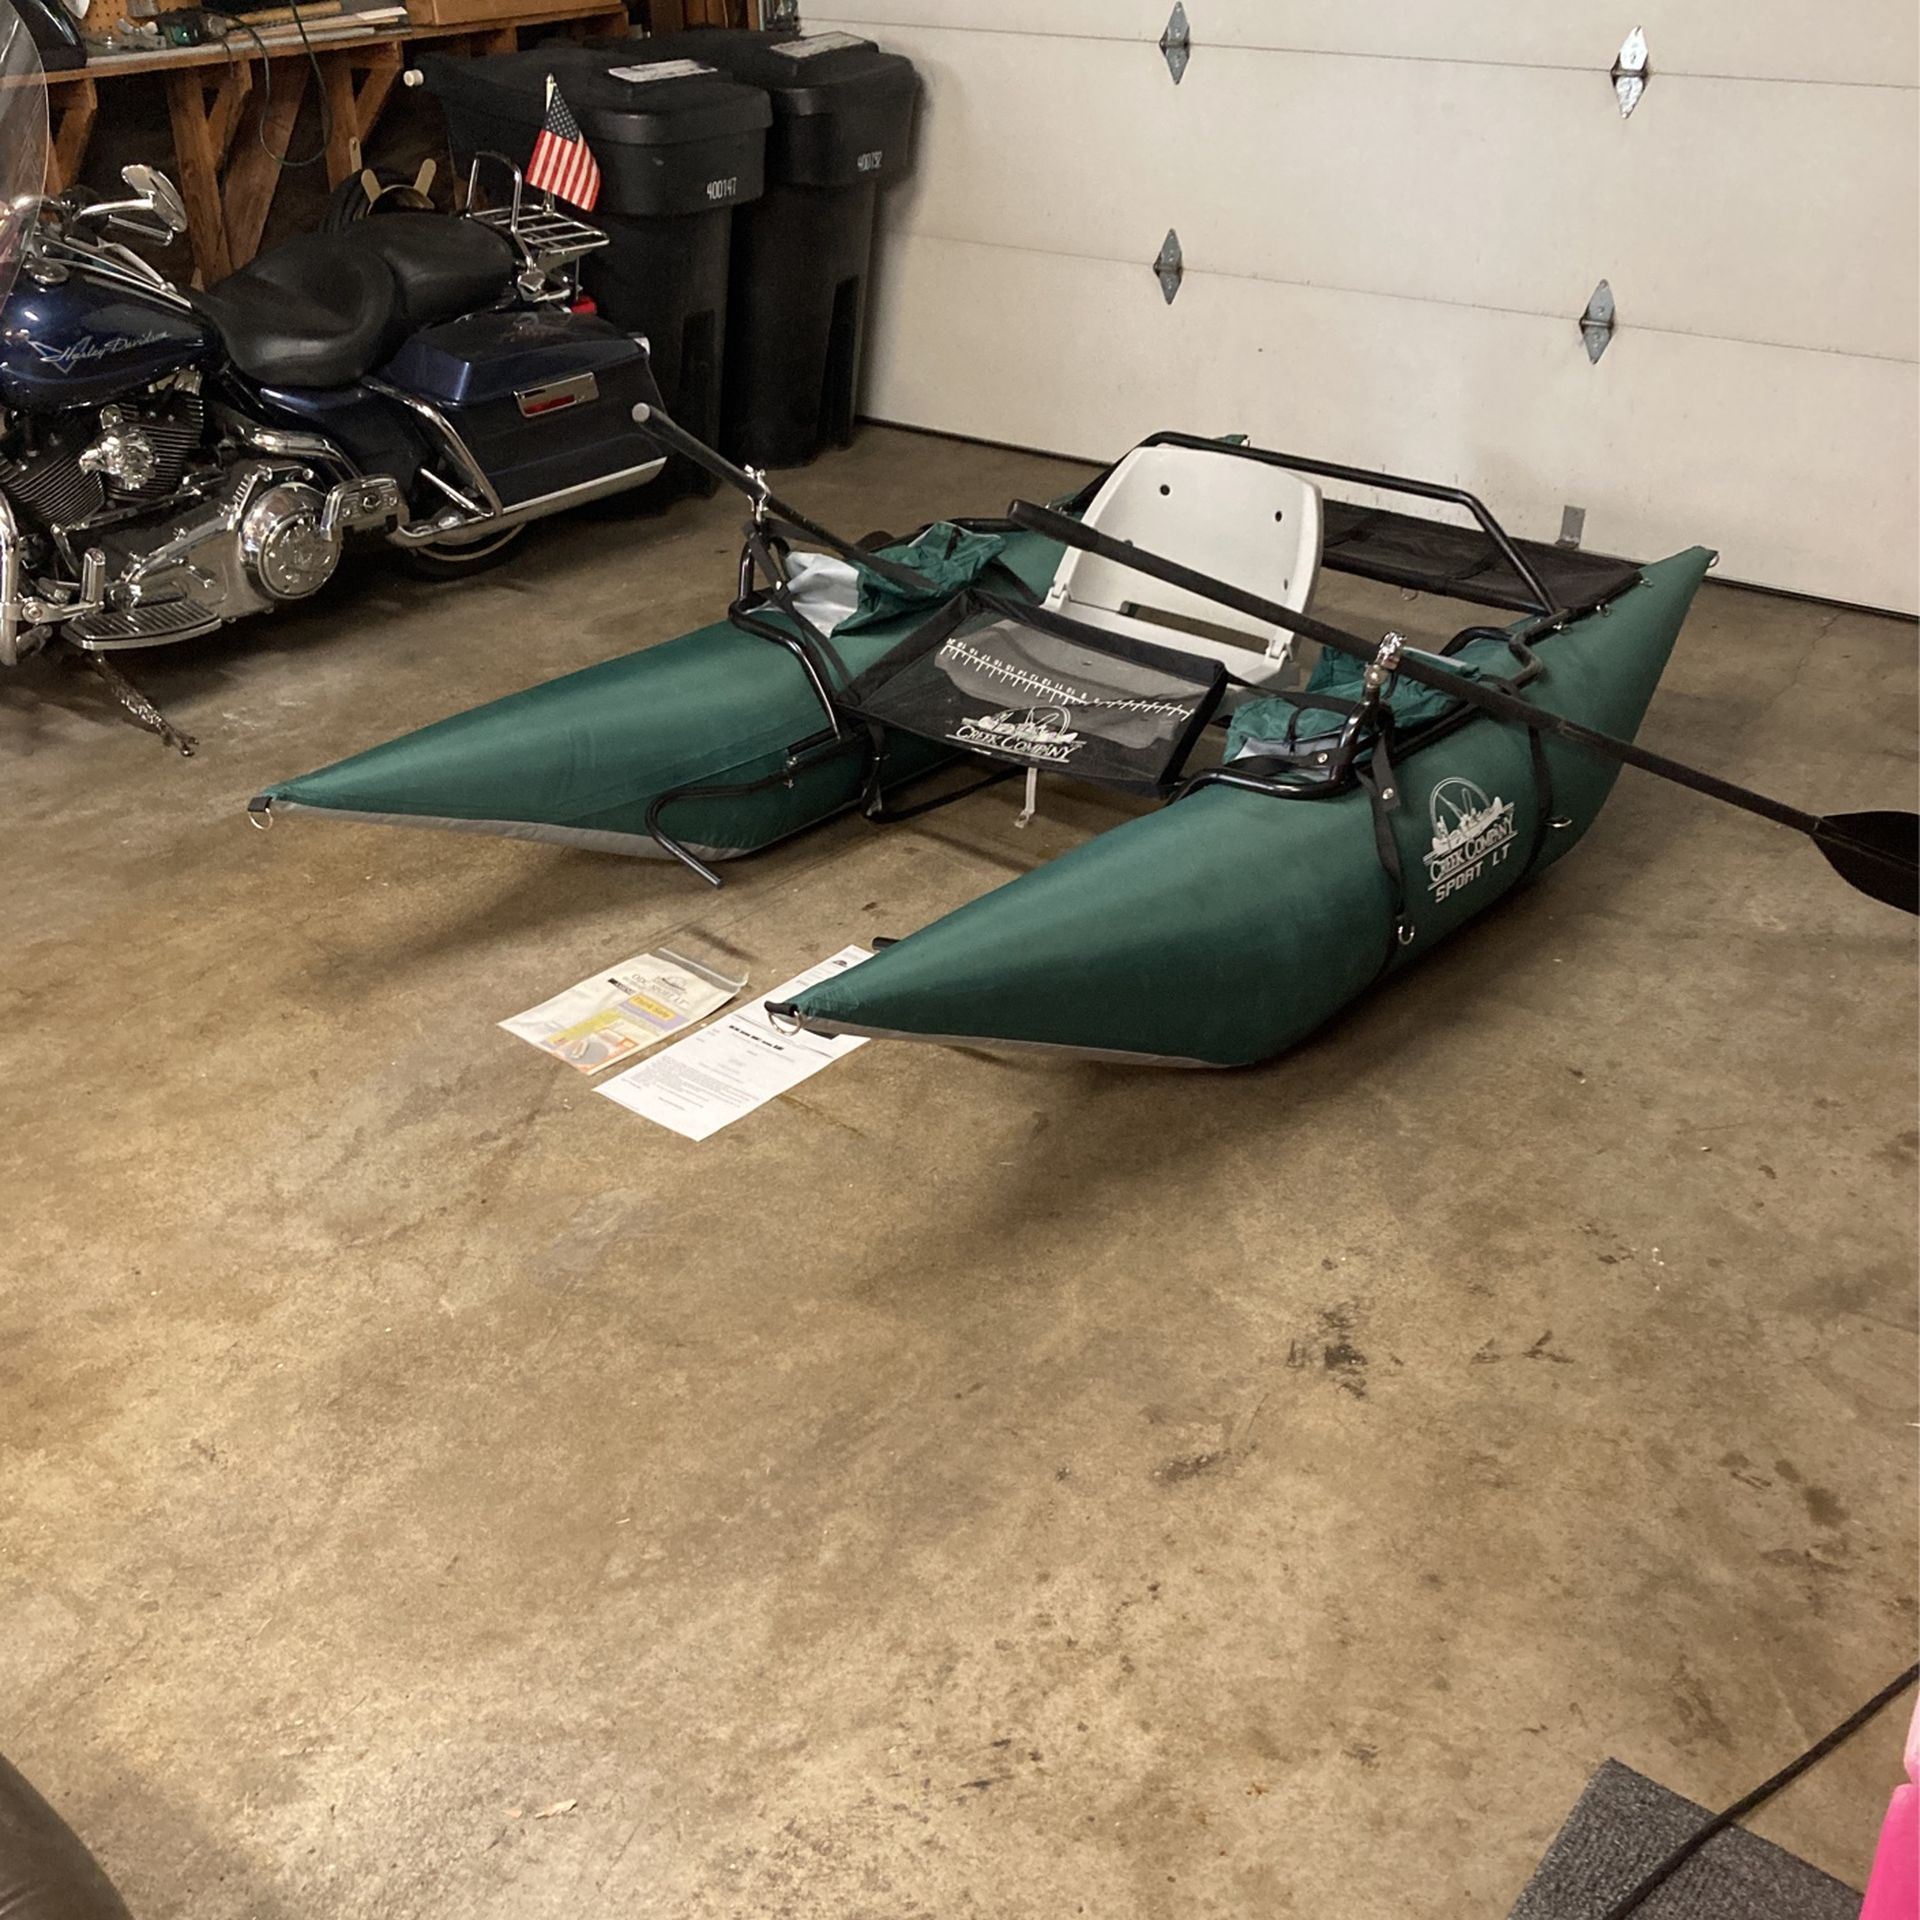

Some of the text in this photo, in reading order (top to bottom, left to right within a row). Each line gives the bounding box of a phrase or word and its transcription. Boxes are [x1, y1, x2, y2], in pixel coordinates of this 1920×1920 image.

[706, 177, 736, 200] 400147
[956, 725, 1082, 760] CREEK COMPANY
[1436, 842, 1511, 903] SPORT LT
